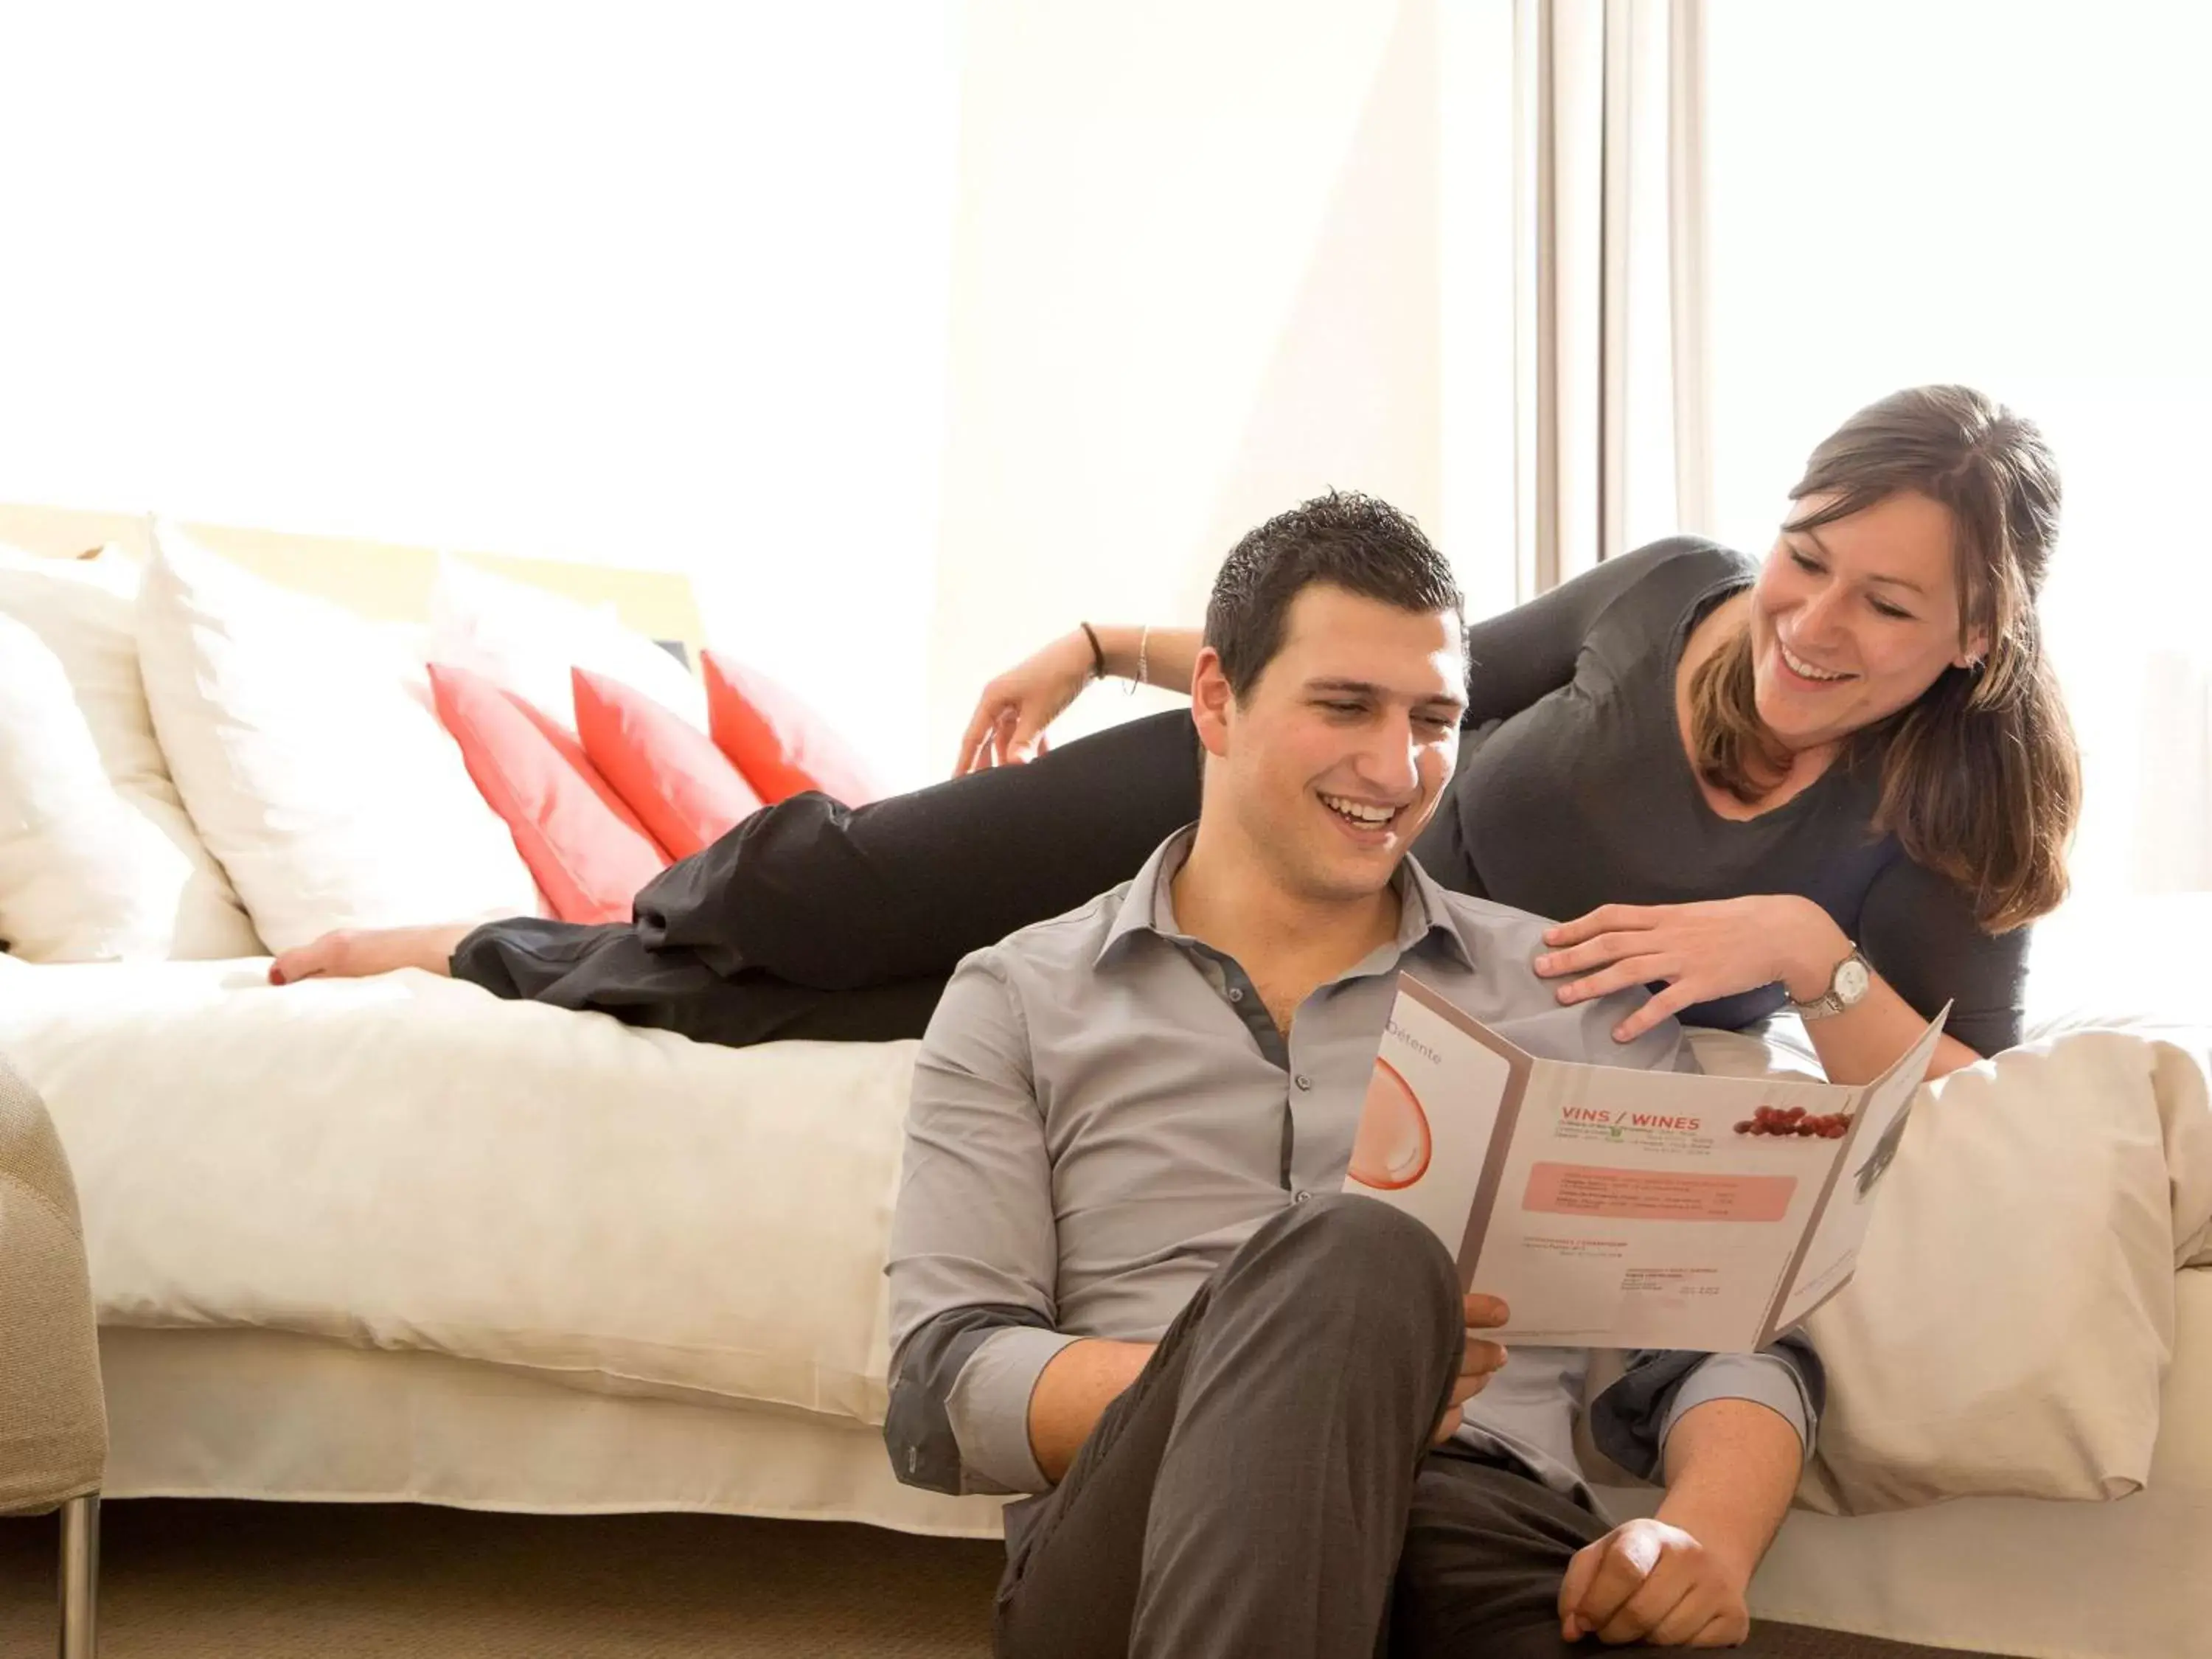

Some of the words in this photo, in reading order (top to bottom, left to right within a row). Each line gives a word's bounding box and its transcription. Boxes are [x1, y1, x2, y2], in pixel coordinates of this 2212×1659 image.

[1385, 1019, 1441, 1065] Détente
[1562, 1106, 1610, 1121] VINS
[1615, 1112, 1627, 1124] /
[1632, 1113, 1700, 1130] WINES
